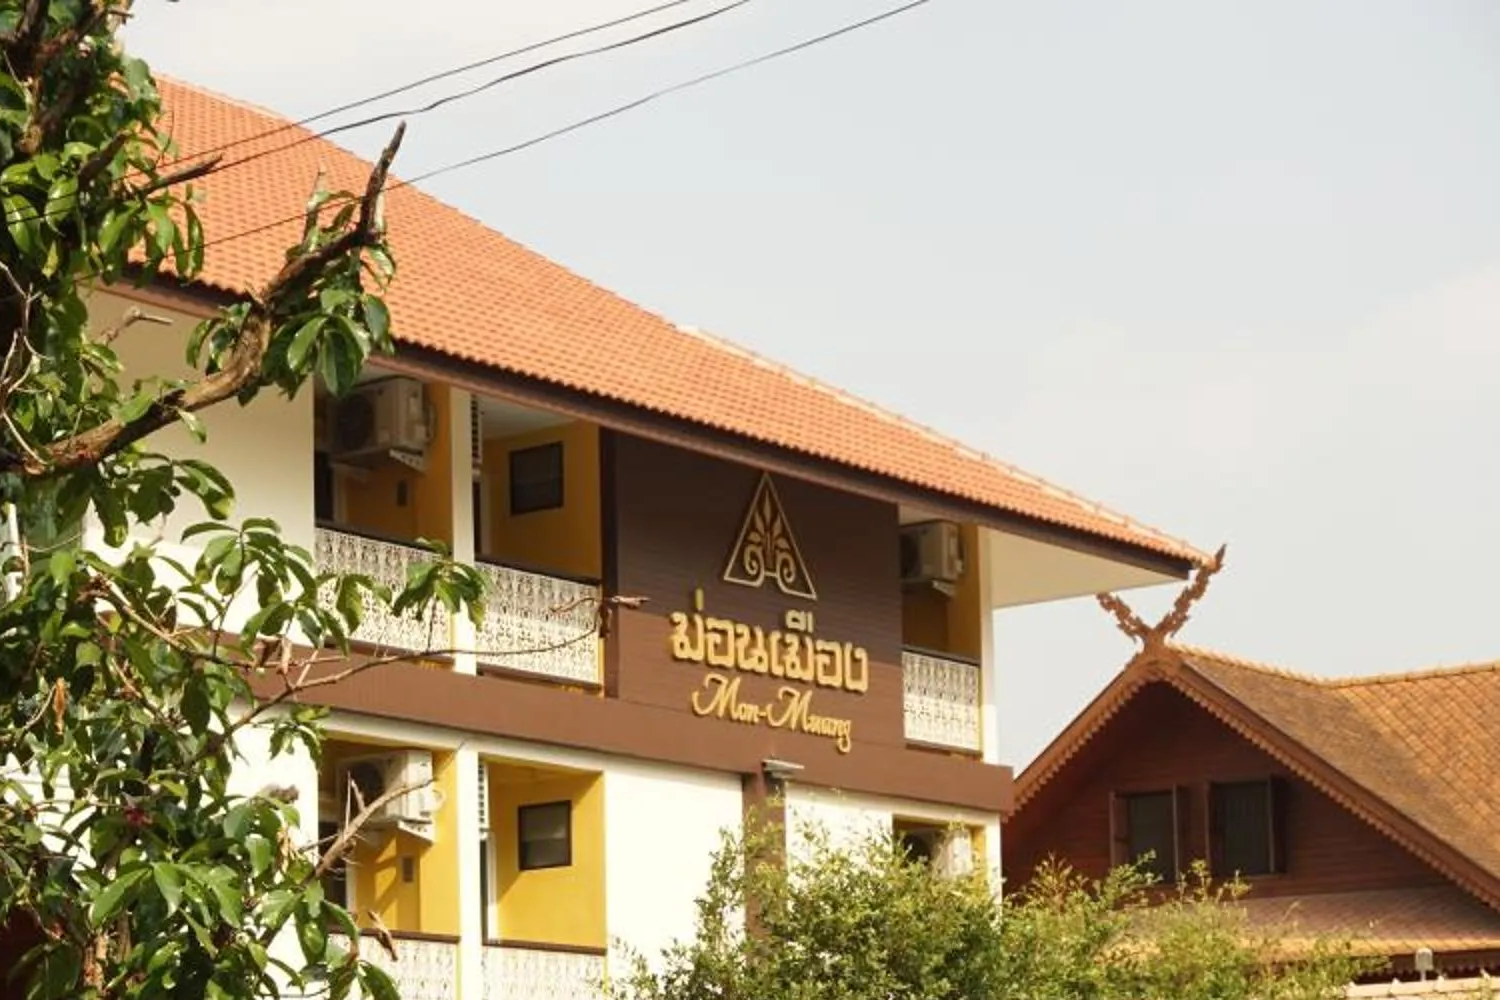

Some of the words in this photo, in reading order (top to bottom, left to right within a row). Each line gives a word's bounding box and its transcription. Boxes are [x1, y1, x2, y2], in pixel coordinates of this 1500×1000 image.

[670, 589, 869, 693] ม่อนเมือง
[692, 673, 852, 753] Mon-Muang
